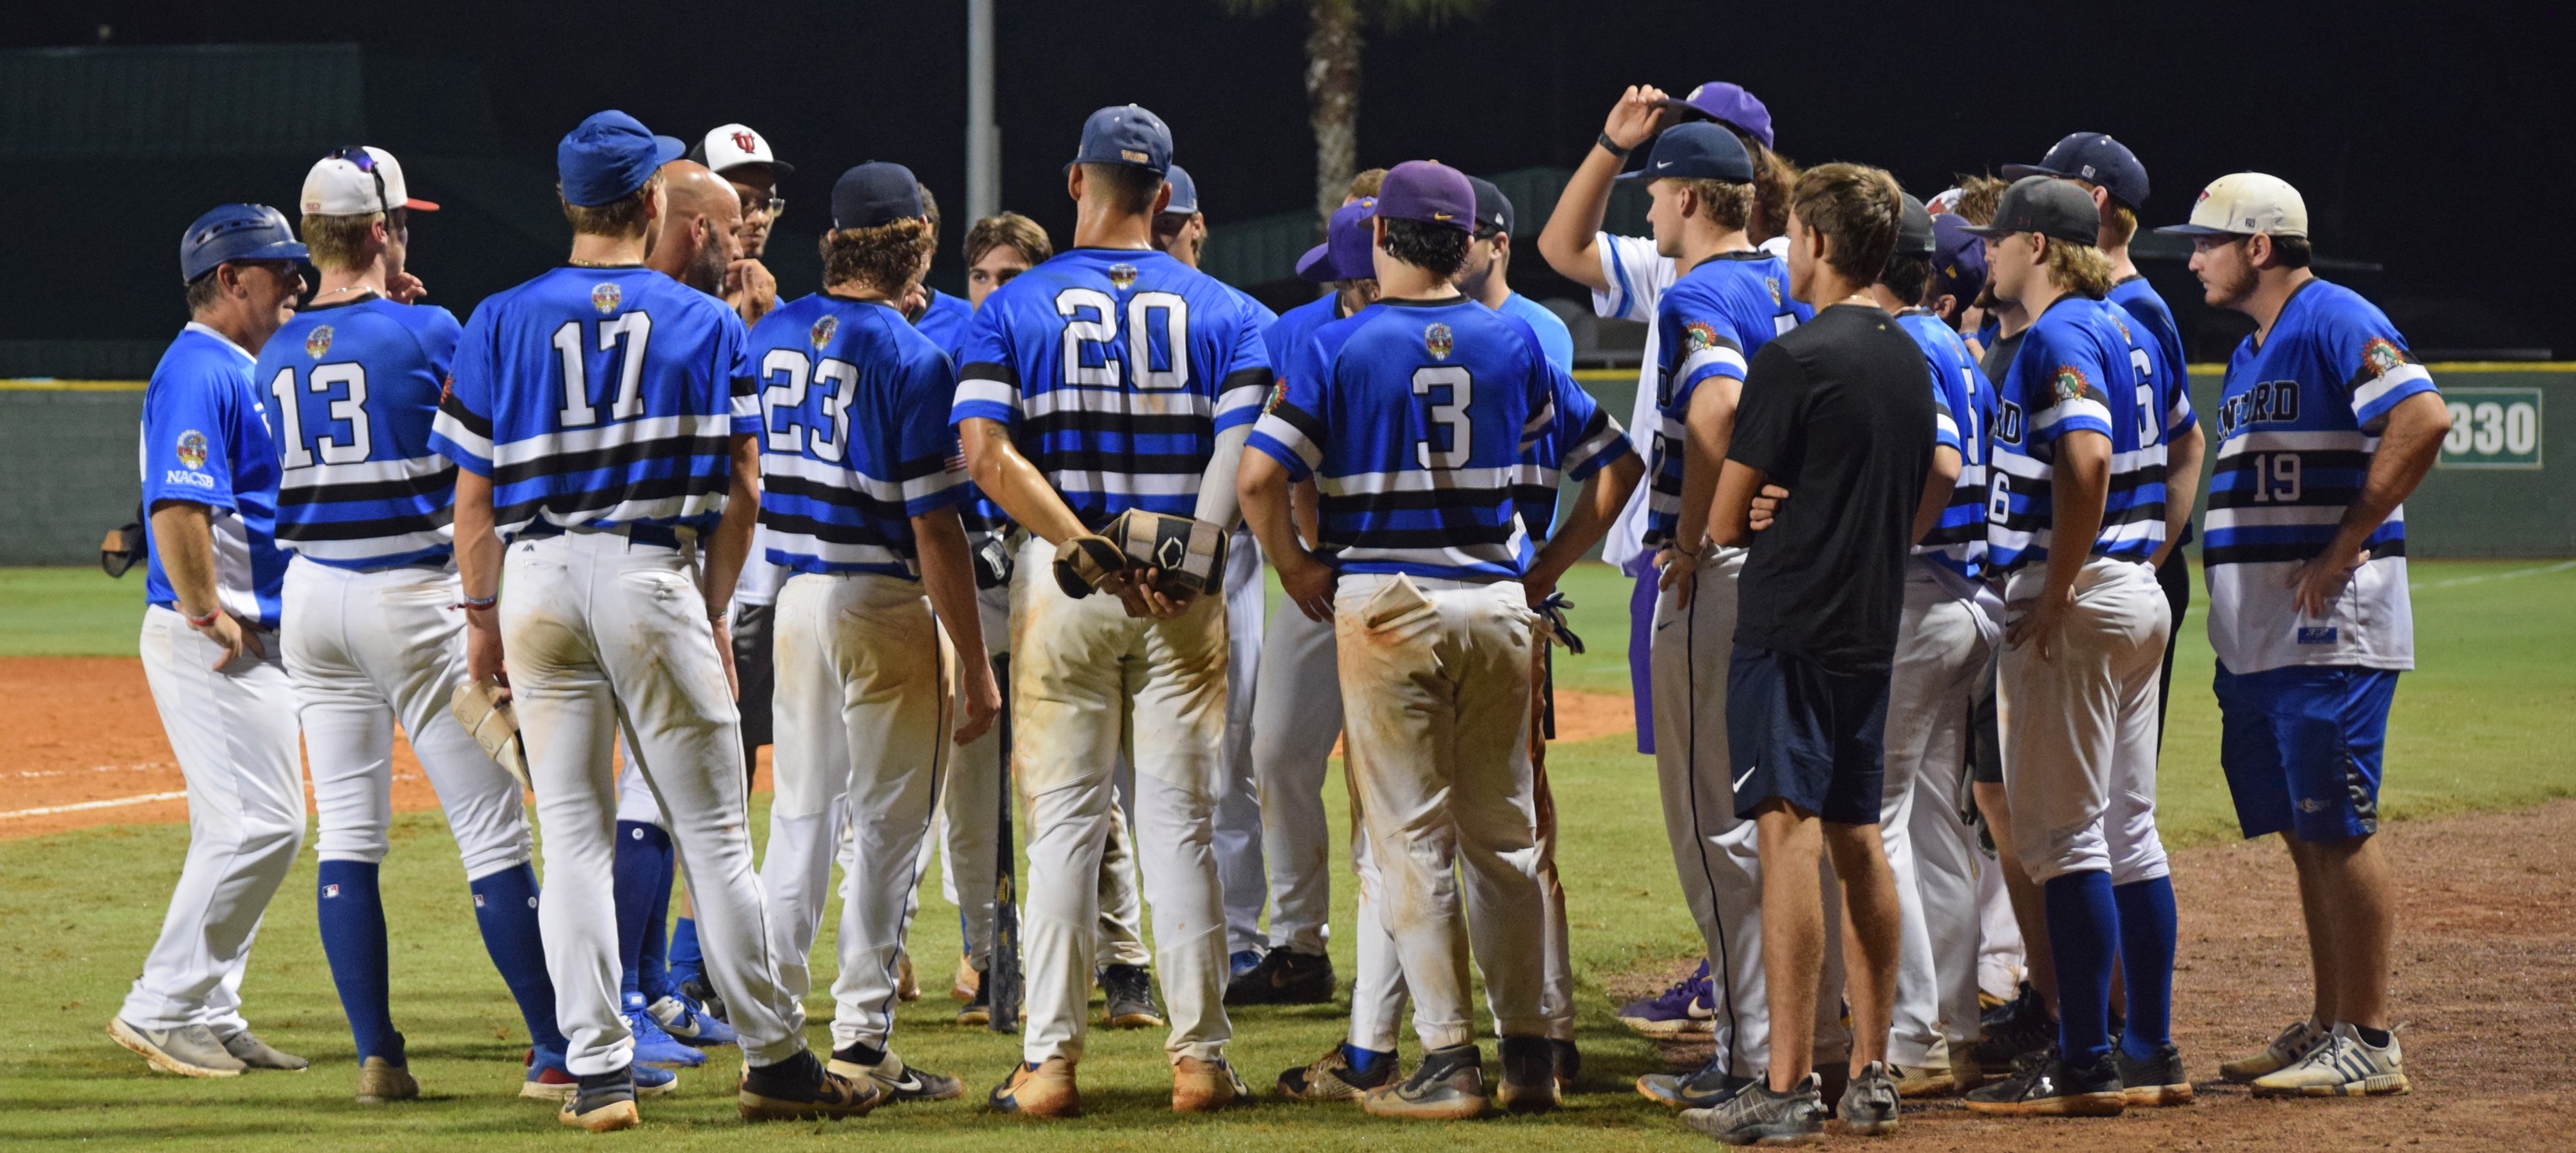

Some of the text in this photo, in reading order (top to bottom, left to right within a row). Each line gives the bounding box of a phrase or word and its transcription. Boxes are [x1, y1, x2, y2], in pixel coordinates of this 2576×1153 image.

[551, 309, 654, 428] 17
[1054, 287, 1189, 391] 20
[271, 360, 373, 470] 13
[761, 347, 860, 464] 23
[1410, 364, 1474, 471] 3
[2442, 401, 2536, 455] 330
[166, 470, 214, 489] NACSB
[1989, 470, 2010, 525] 6
[2254, 453, 2301, 502] 19
